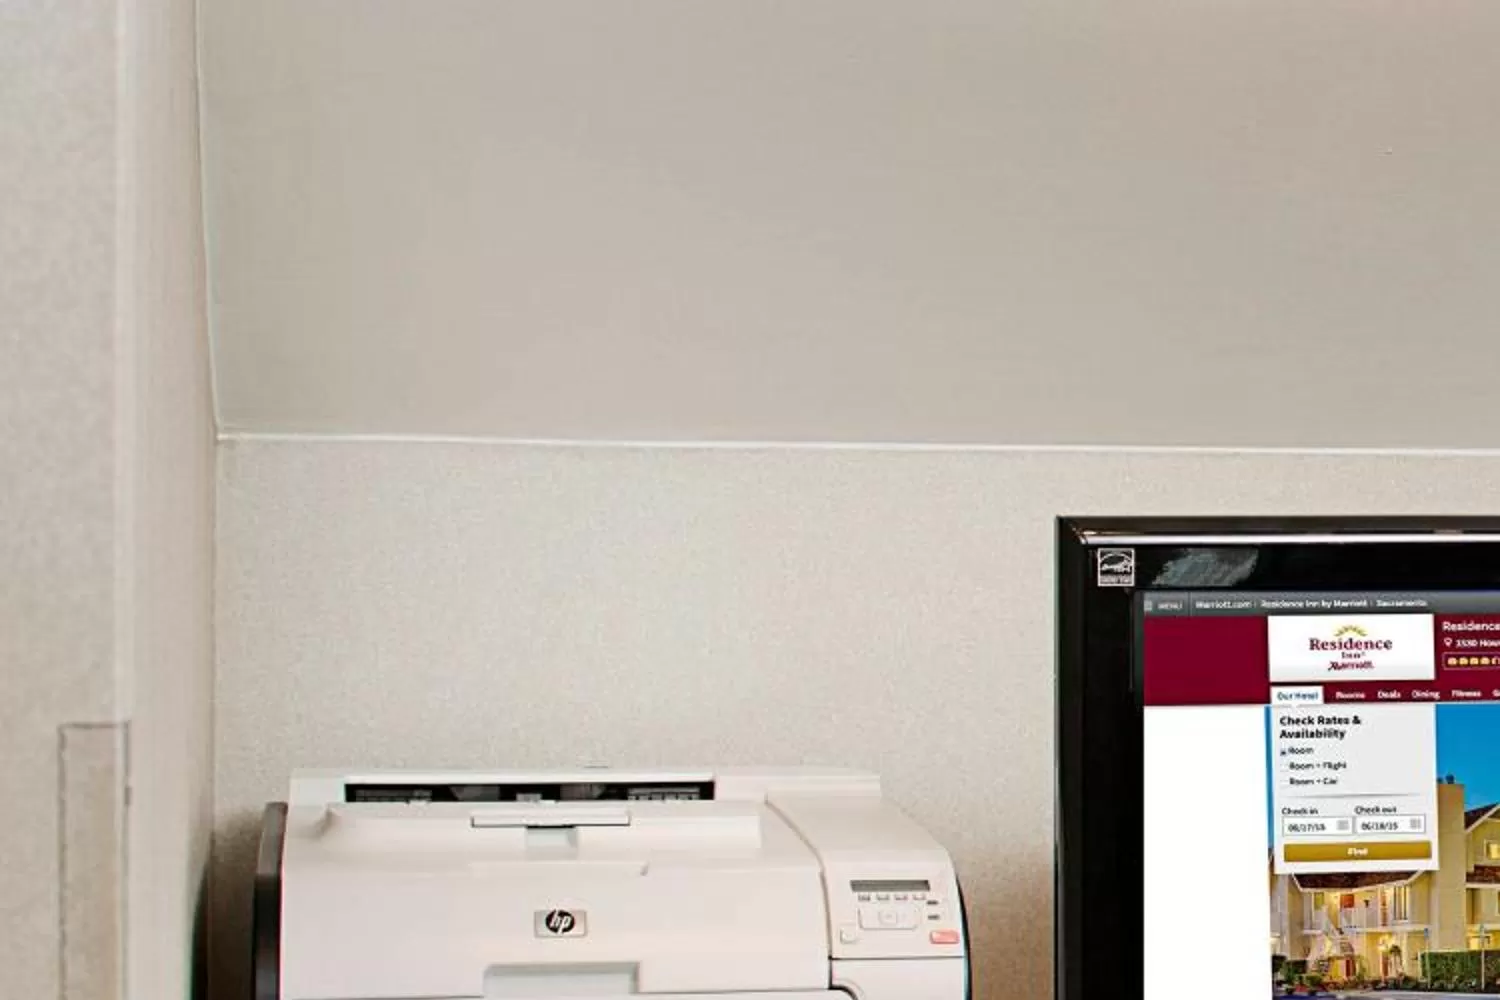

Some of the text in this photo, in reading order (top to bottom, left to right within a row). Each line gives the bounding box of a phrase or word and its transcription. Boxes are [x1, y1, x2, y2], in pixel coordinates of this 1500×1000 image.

[1442, 621, 1500, 631] Residence
[1309, 637, 1393, 651] Residence
[1279, 715, 1362, 726] Check Rates &
[1279, 729, 1347, 740] Availability
[547, 908, 574, 934] hp
